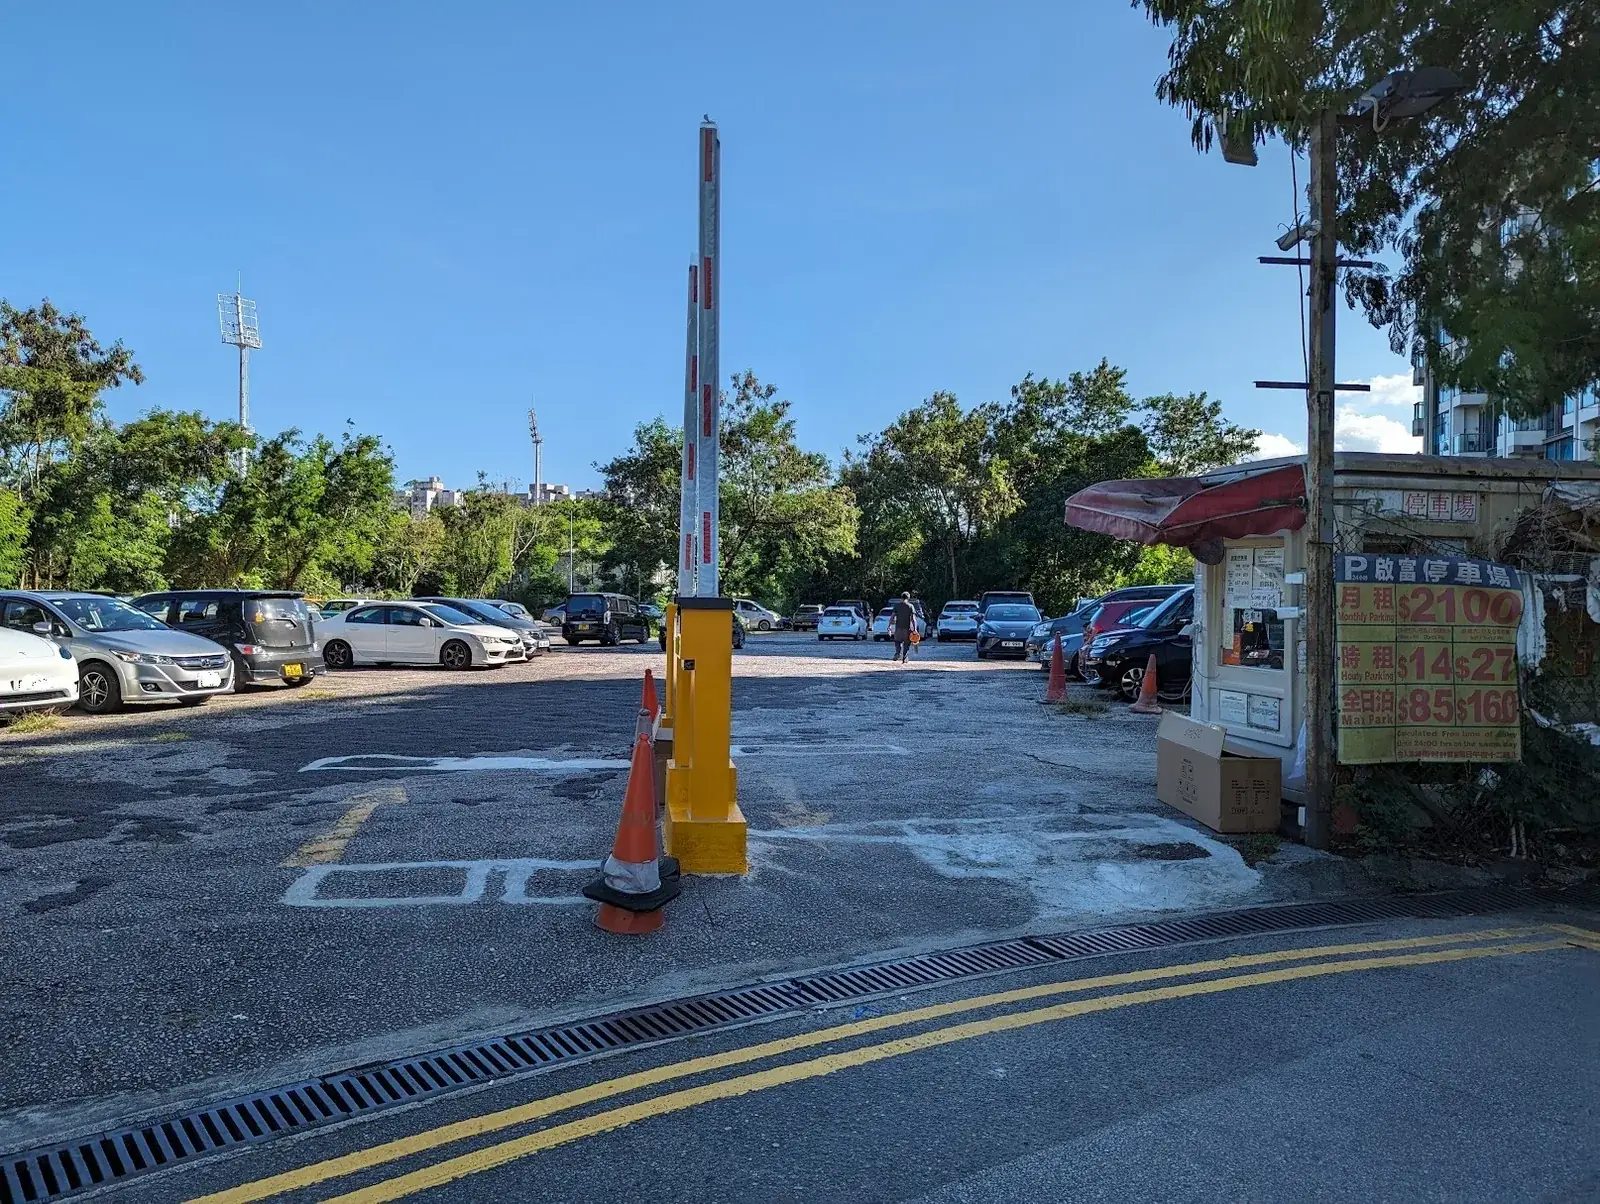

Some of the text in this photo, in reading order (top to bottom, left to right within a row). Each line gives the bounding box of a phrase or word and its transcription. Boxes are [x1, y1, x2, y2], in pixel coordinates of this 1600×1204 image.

[1406, 493, 1475, 518] 停車場
[1345, 556, 1368, 581] P
[1338, 612, 1395, 624] Monthly Parking
[1398, 586, 1521, 625] $2100
[1398, 646, 1452, 681] $14
[1455, 647, 1514, 681] $27
[1364, 671, 1394, 682] Parking
[1342, 688, 1394, 713] 全日泊
[1398, 688, 1454, 723] $85
[1457, 689, 1517, 724] $160
[1342, 714, 1394, 725] Max Park
